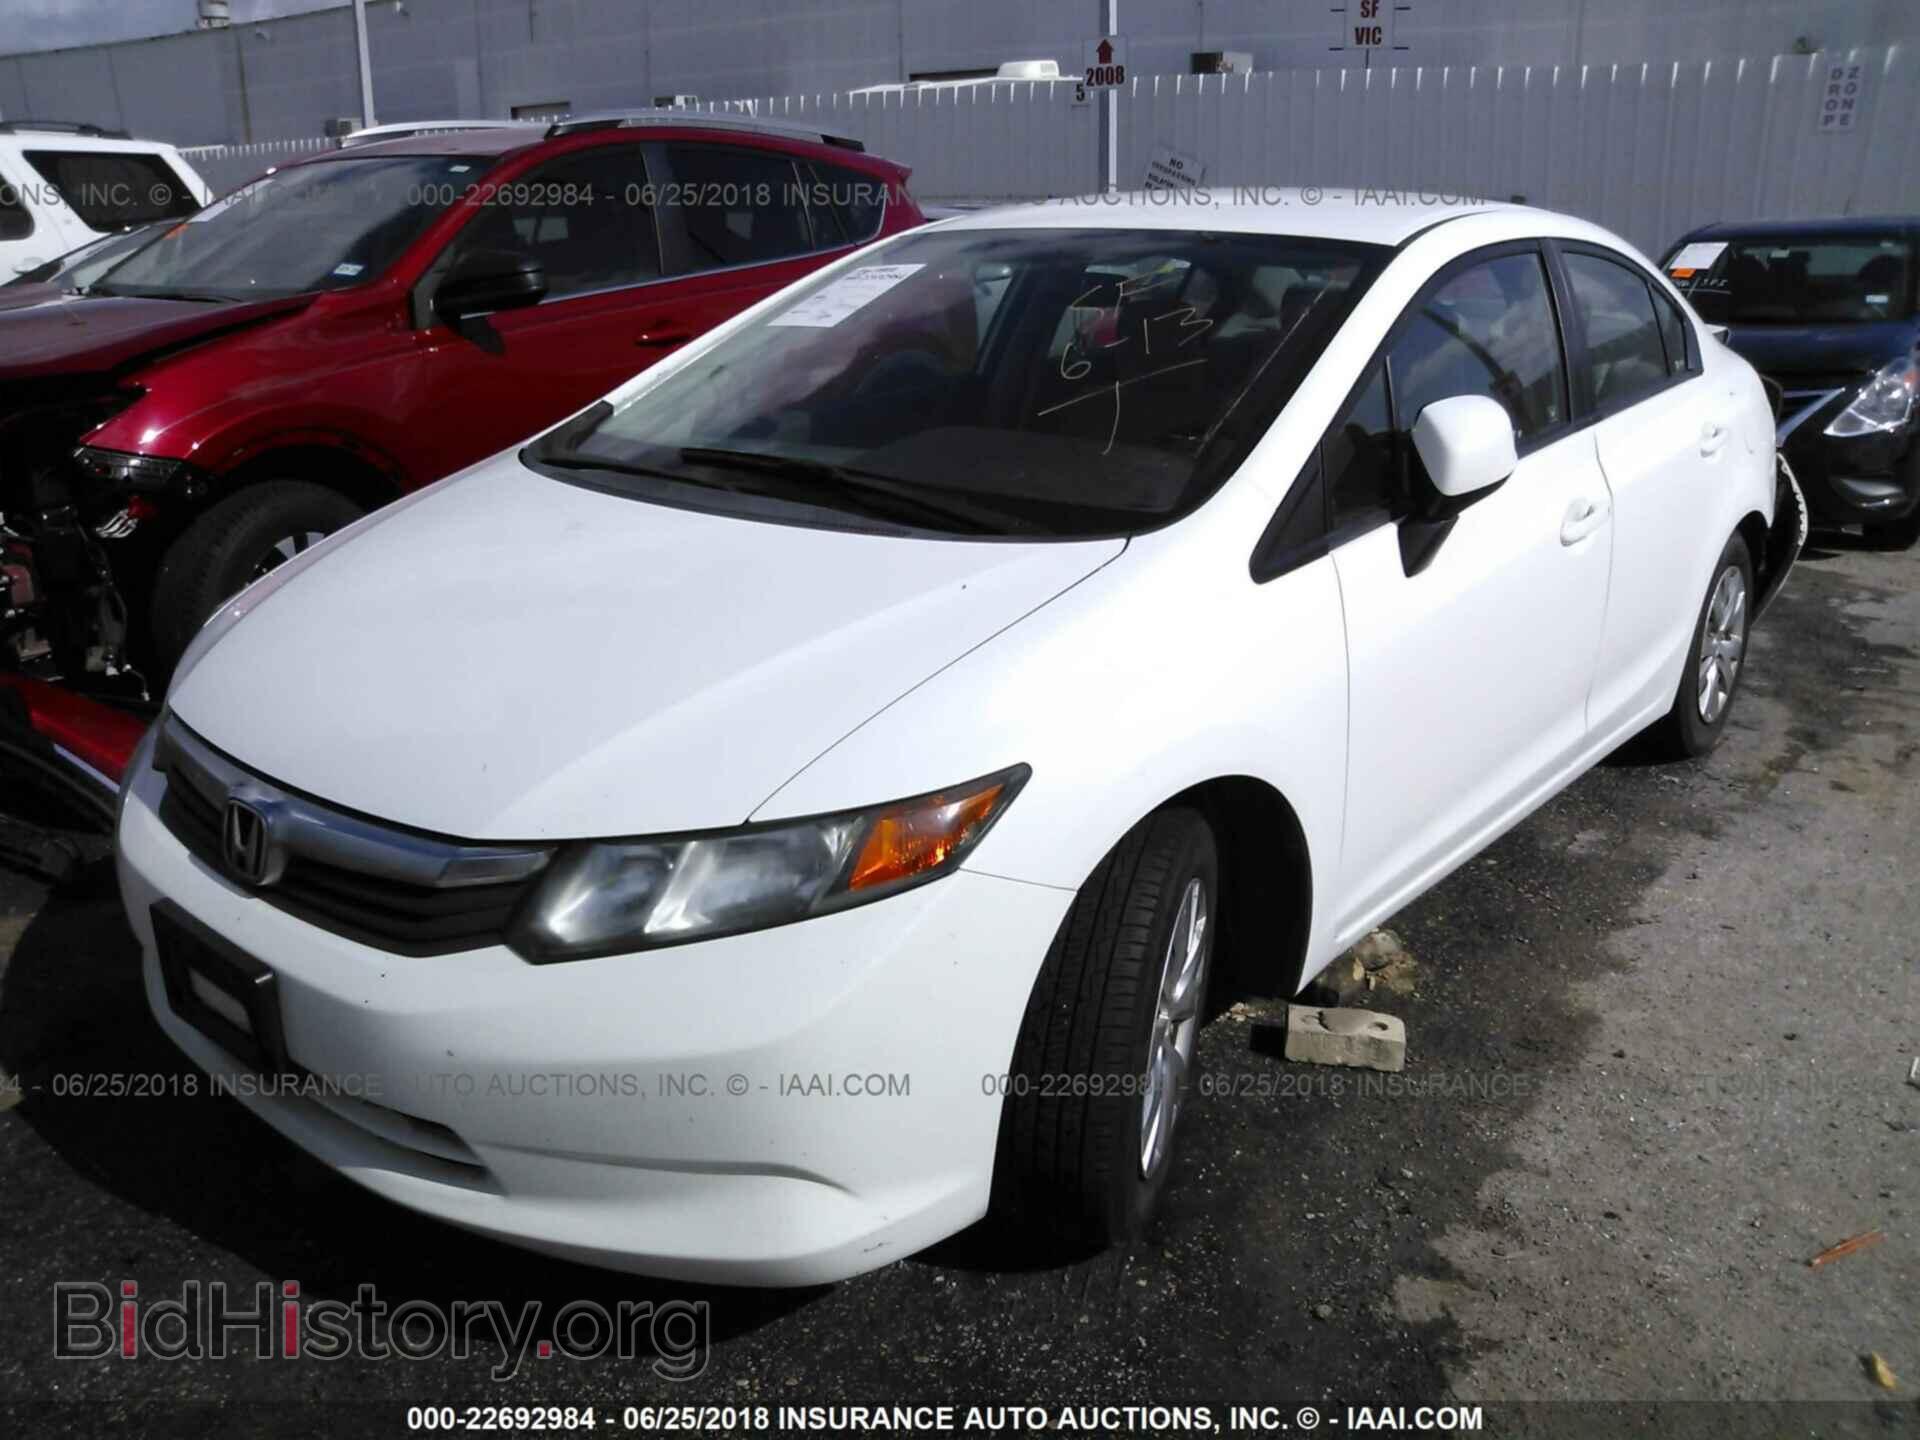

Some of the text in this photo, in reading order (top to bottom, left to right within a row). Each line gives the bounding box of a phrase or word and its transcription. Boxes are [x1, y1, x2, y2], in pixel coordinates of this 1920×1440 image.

[1360, 0, 1380, 18] SF
[1354, 26, 1382, 45] VIC
[1086, 65, 1125, 87] 2008
[1076, 83, 1085, 102] 5
[1169, 157, 1184, 170] NO
